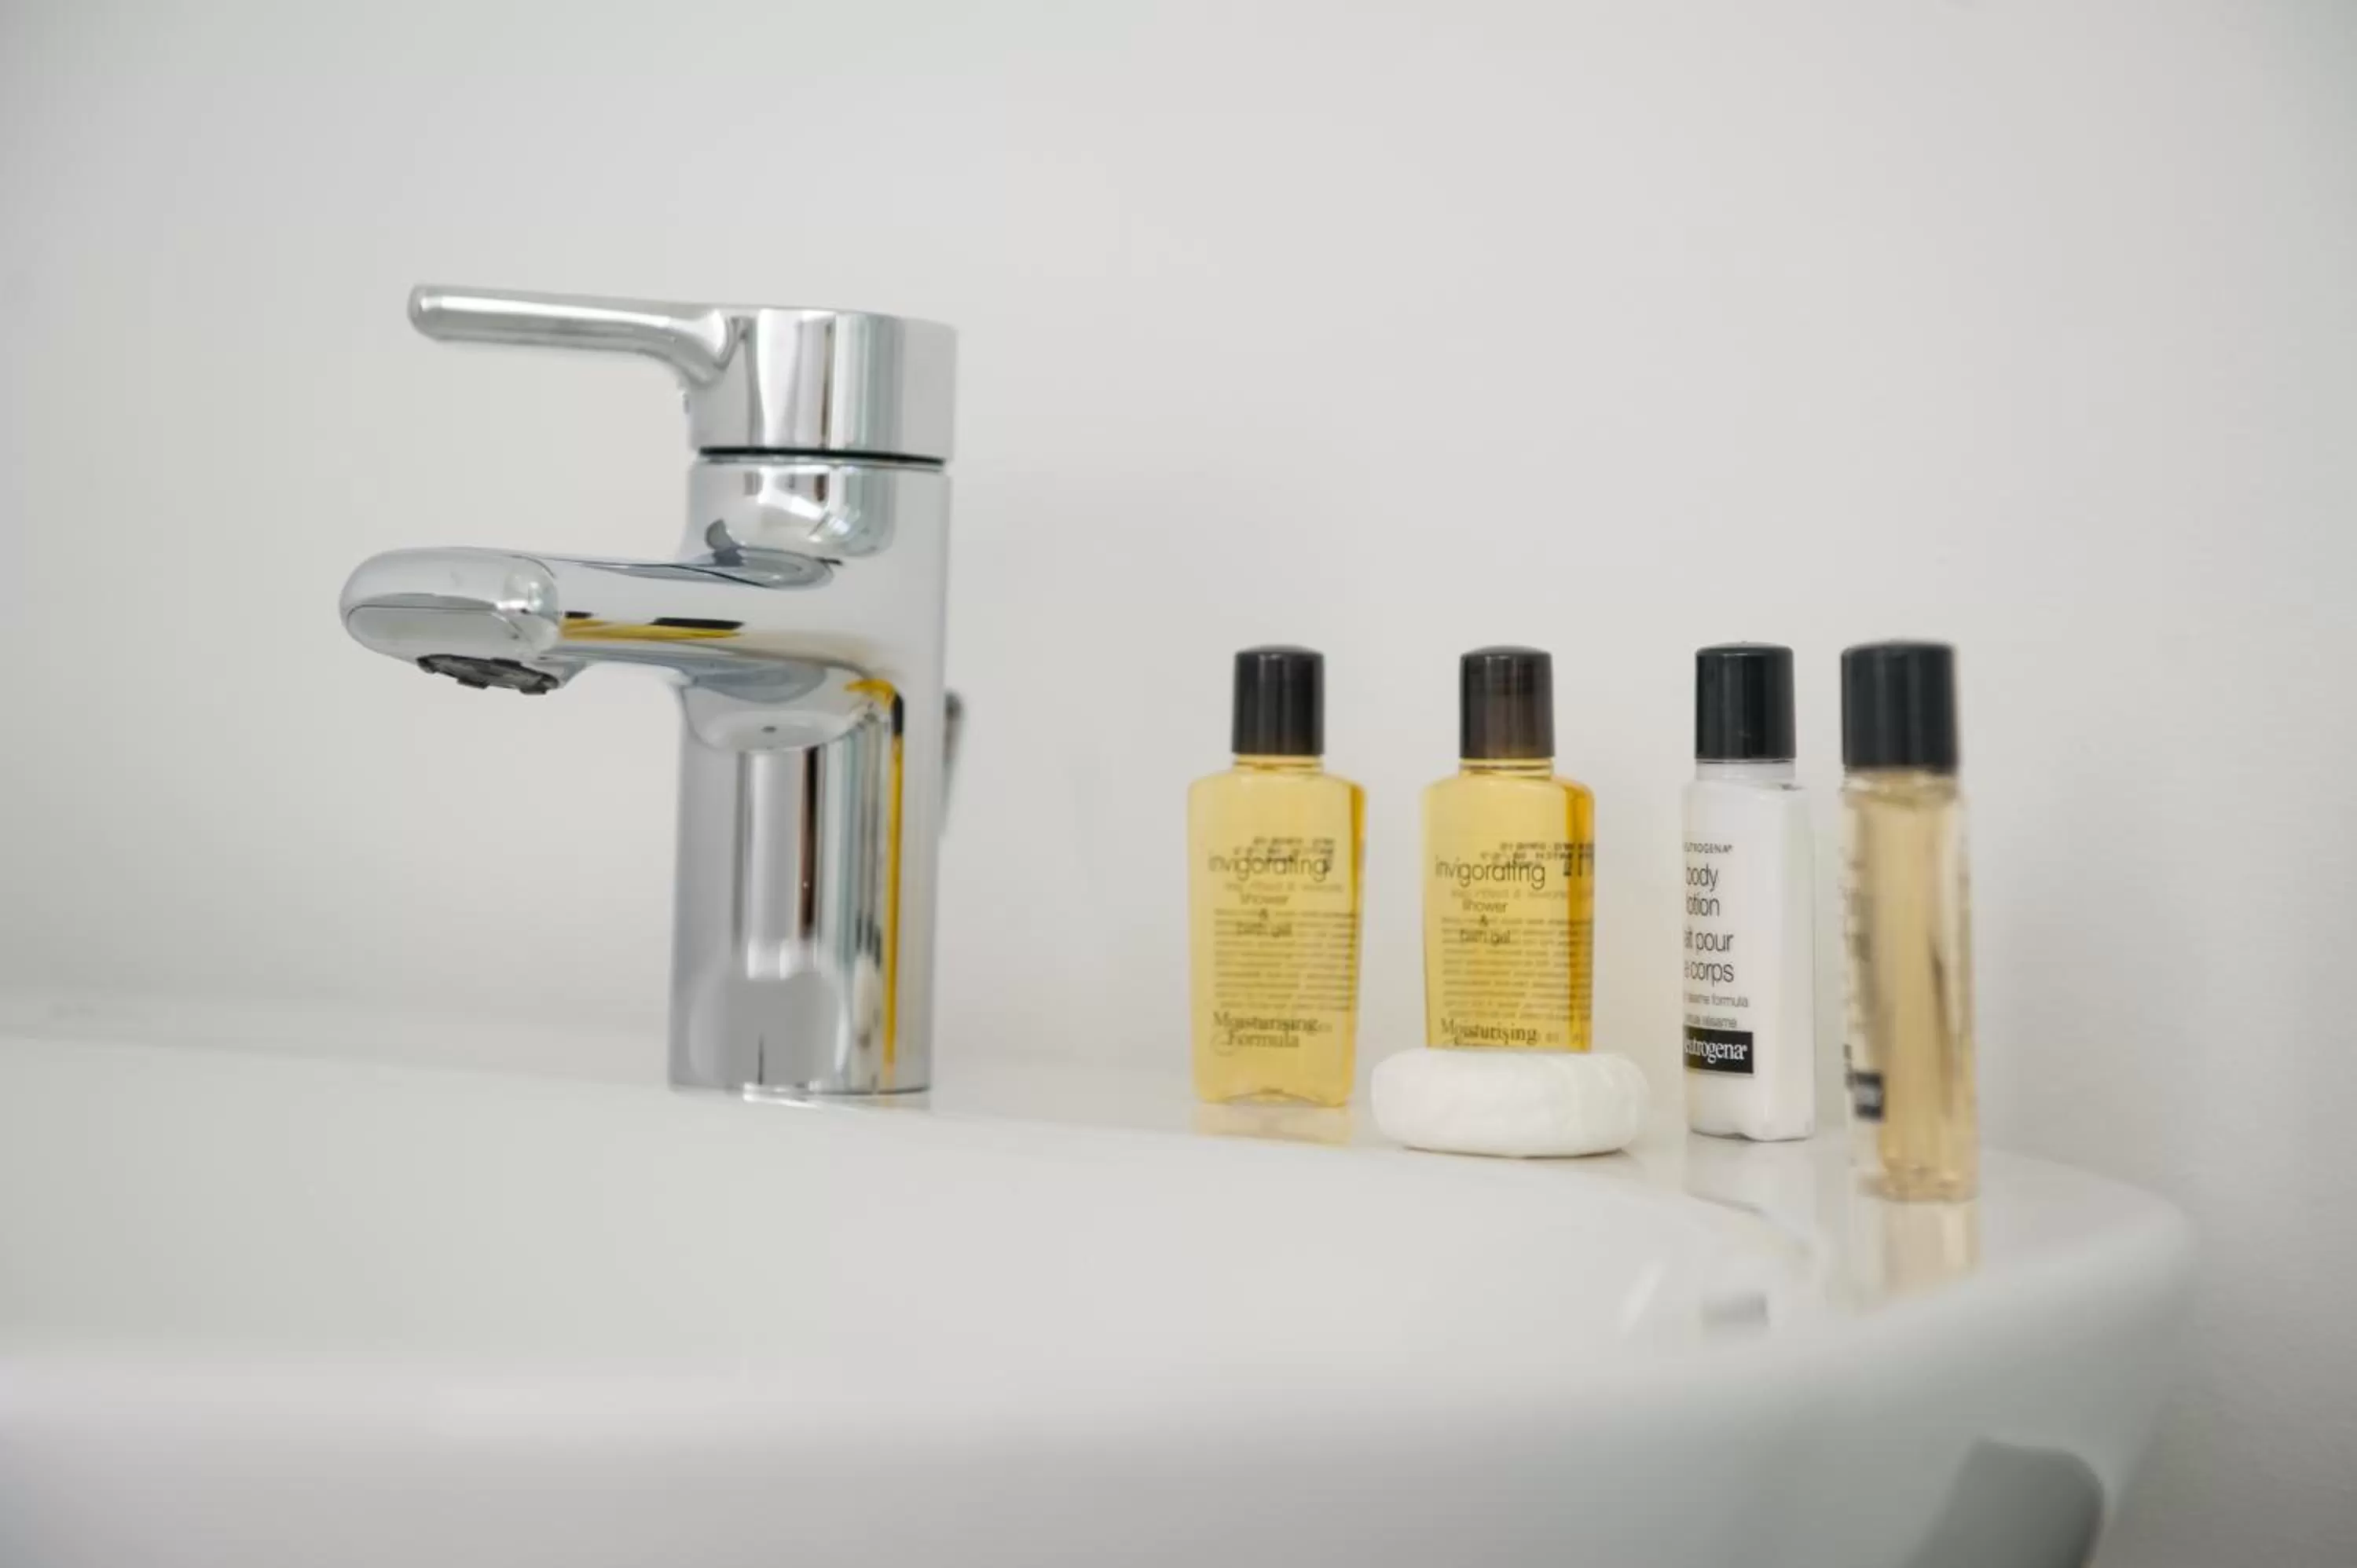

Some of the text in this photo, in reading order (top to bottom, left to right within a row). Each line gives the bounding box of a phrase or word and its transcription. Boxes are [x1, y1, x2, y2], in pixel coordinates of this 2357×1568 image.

[1208, 847, 1329, 882] invigorating
[1435, 854, 1545, 889] invigorating
[1695, 931, 1734, 954] pour
[1690, 961, 1734, 987] corps
[1441, 1018, 1538, 1046] Moisturising
